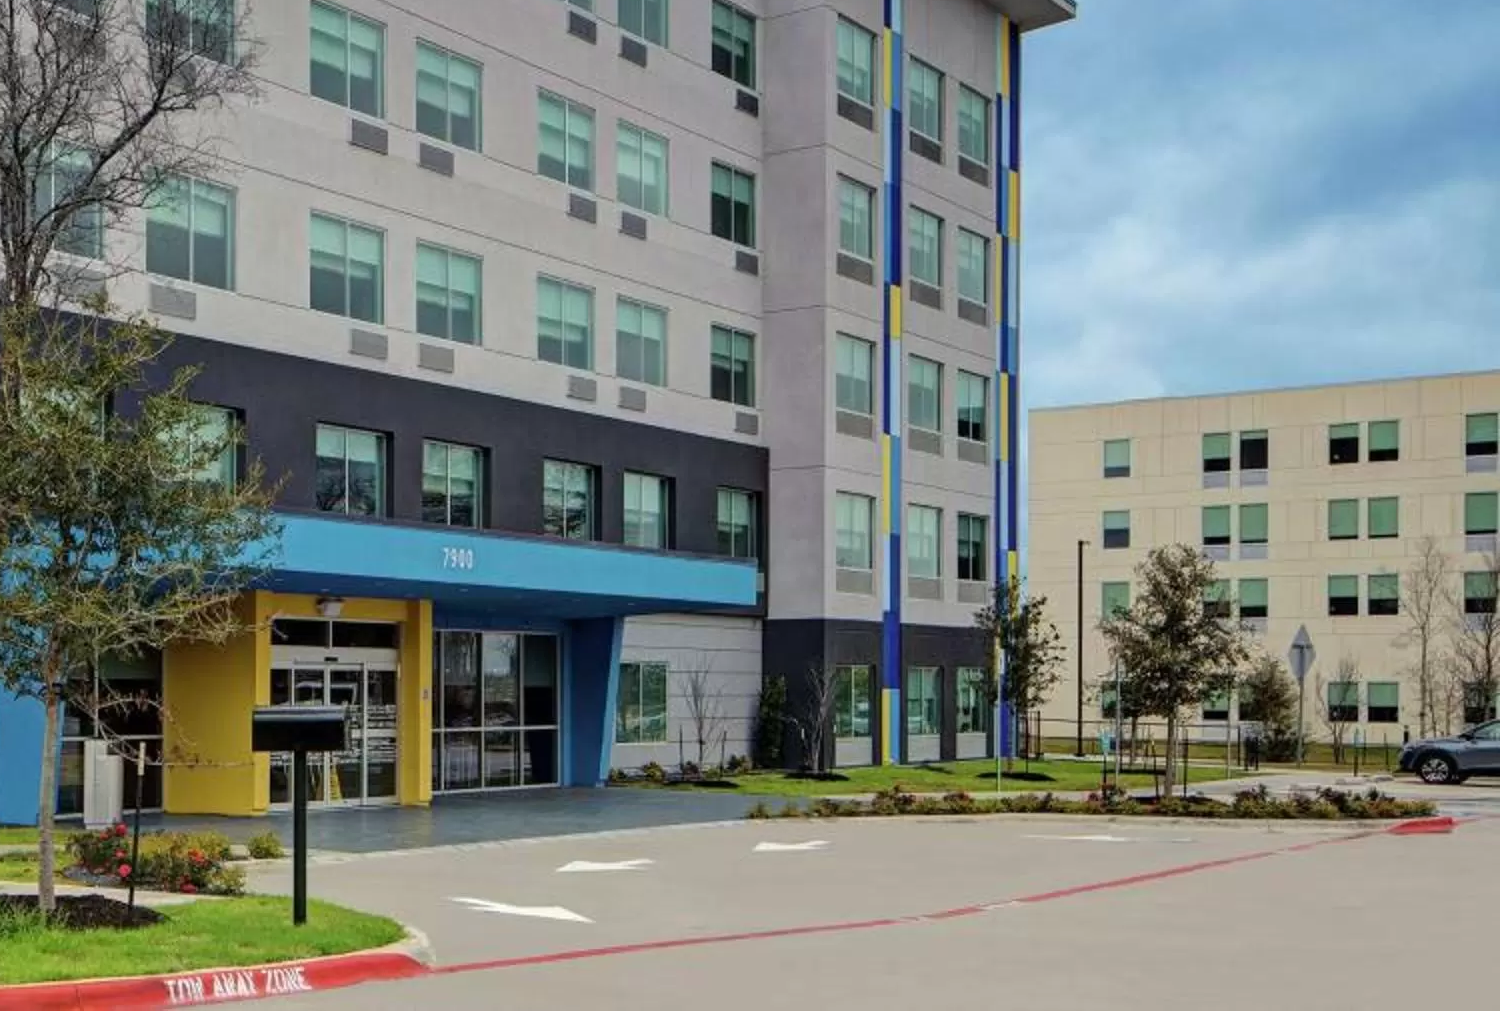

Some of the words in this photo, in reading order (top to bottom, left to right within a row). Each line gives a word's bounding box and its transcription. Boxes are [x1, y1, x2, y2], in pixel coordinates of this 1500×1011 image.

[164, 977, 204, 1004] TOW
[213, 971, 257, 997] AWAY
[261, 967, 312, 994] ZONE
